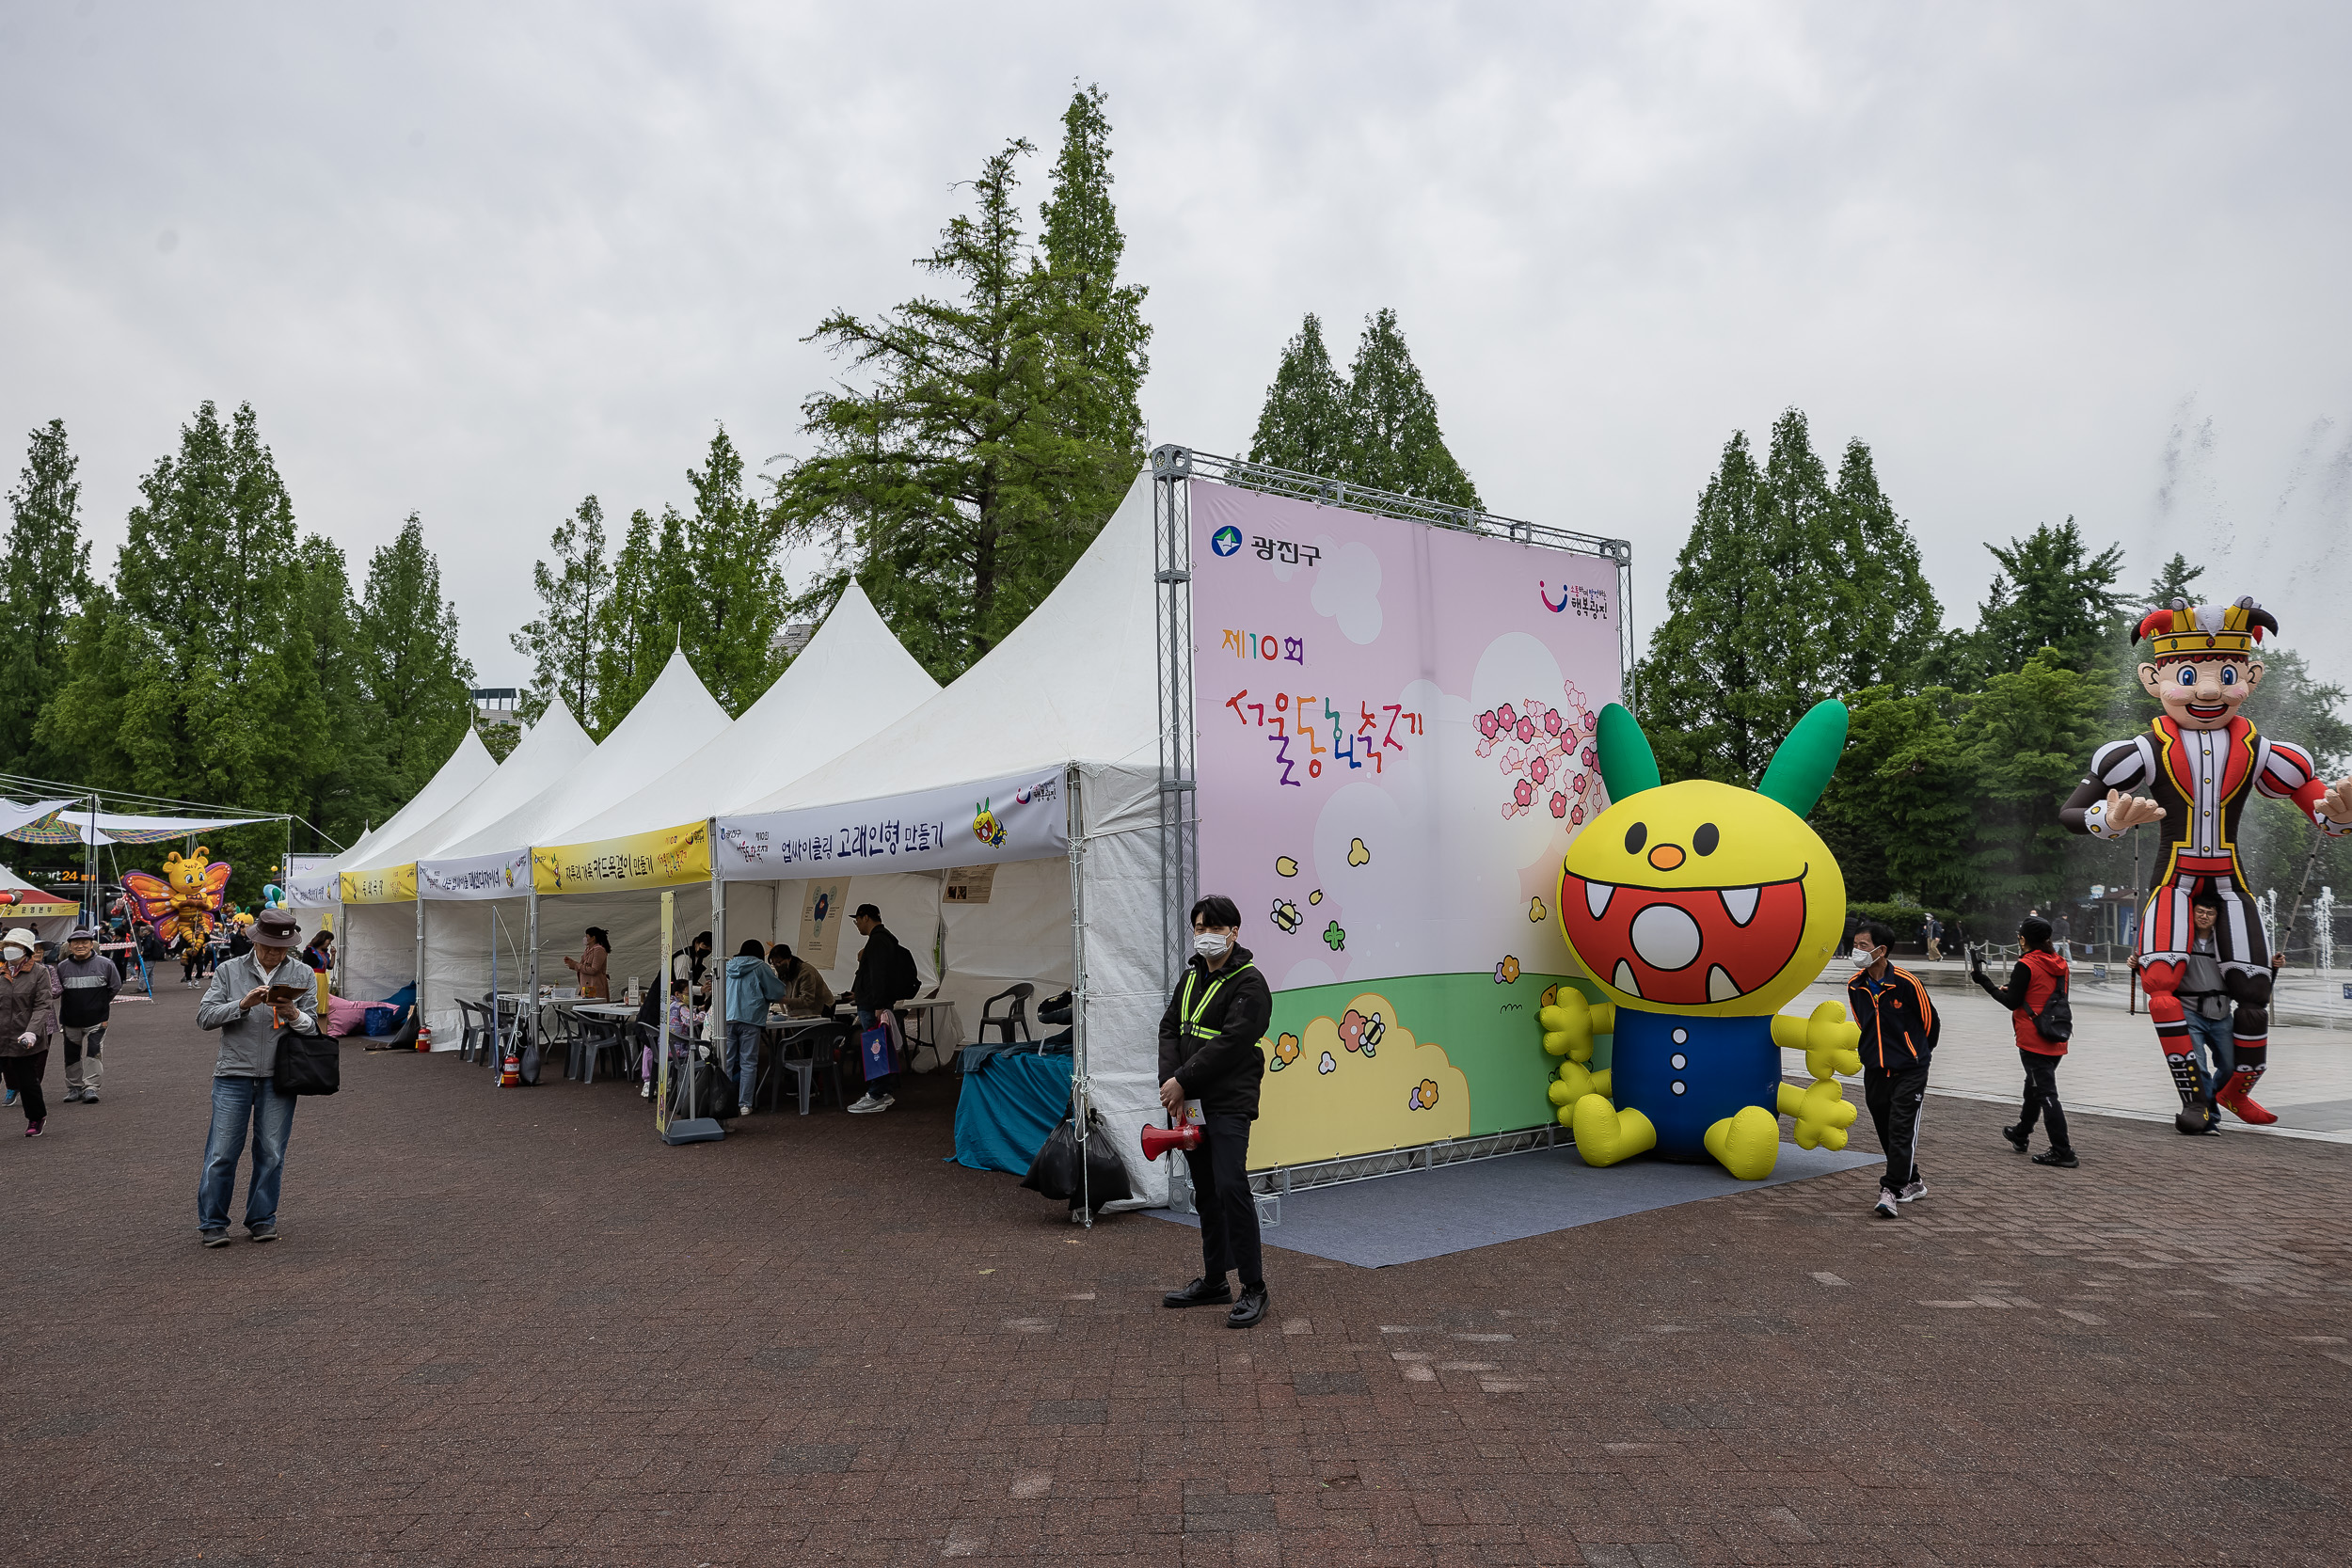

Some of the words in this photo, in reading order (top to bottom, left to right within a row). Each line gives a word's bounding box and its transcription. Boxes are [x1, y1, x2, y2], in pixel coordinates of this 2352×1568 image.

[1249, 534, 1323, 567] 광진구
[1570, 585, 1588, 598] 소통하며
[1588, 588, 1607, 601] 발전하는
[1571, 596, 1608, 620] 행복광진
[1221, 628, 1304, 666] 제10회
[781, 834, 833, 863] 업싸이클링
[836, 819, 900, 858] 고래인형
[904, 820, 944, 852] 만들기
[593, 853, 633, 880] 카드목걸이
[633, 854, 655, 877] 만들기
